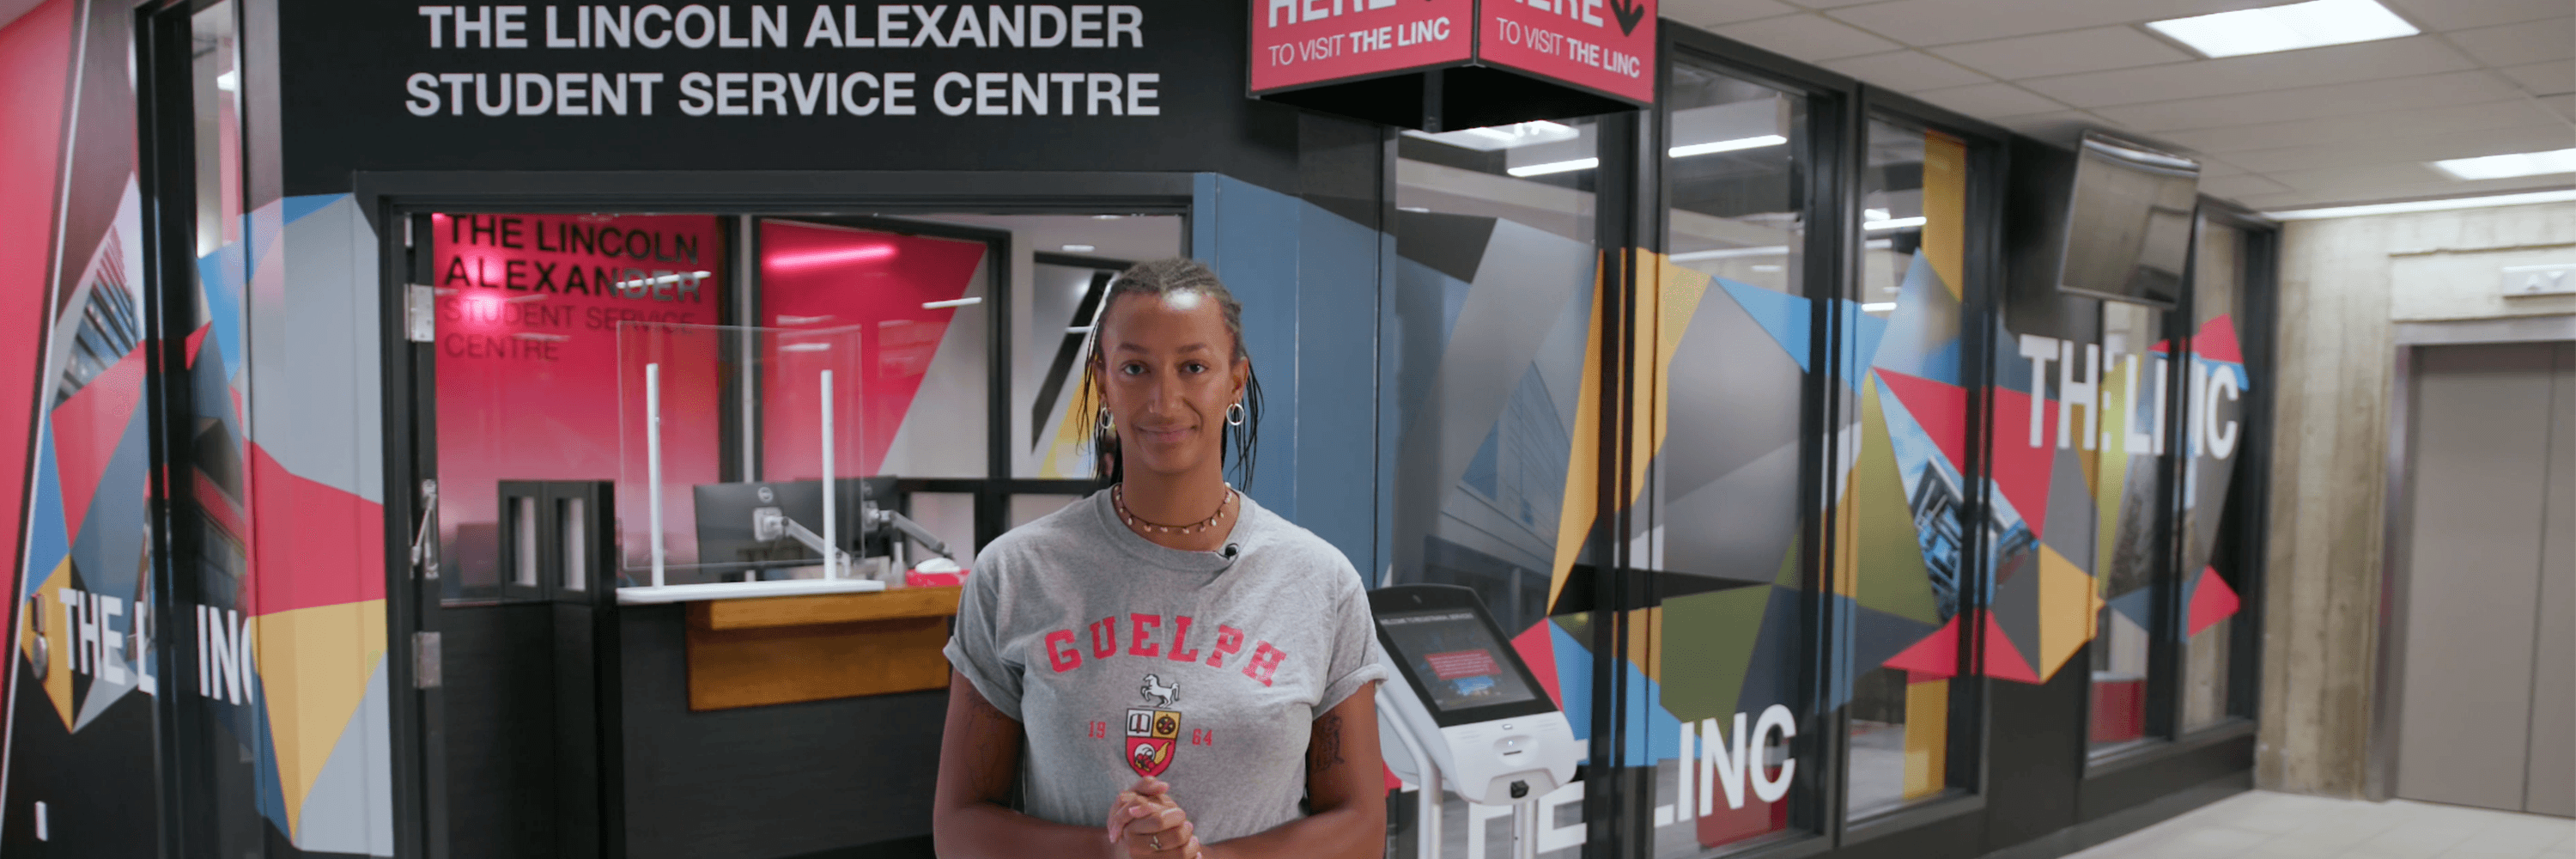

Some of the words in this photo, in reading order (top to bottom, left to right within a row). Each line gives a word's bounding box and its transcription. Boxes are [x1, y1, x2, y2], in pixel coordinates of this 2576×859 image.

[418, 5, 529, 48] THE
[545, 4, 788, 49] LINCOLN
[804, 4, 1145, 48] ALEXANDER
[1269, 0, 1397, 27] HE
[1267, 41, 1295, 66] TO
[1299, 34, 1347, 62] VISIT
[1350, 26, 1393, 54] THE
[1398, 16, 1451, 47] LINC
[1496, 16, 1522, 45] TO
[1524, 25, 1564, 57] VISIT
[1566, 37, 1601, 68] THE
[1603, 48, 1641, 79] LINC
[405, 72, 664, 117] STUDENT
[678, 71, 917, 117] SERVICE
[933, 71, 1162, 117] CENTRE
[445, 214, 525, 250] THE
[537, 221, 699, 265] LINCOLN
[445, 257, 702, 302] ALEXANDER
[586, 304, 696, 335] SERVICE
[443, 332, 561, 361] CENTRE
[58, 587, 126, 685] THE
[1044, 612, 1287, 687] GUELPH
[1088, 721, 1107, 740] 19
[1192, 728, 1212, 746] 64
[1655, 704, 1797, 828] INC
